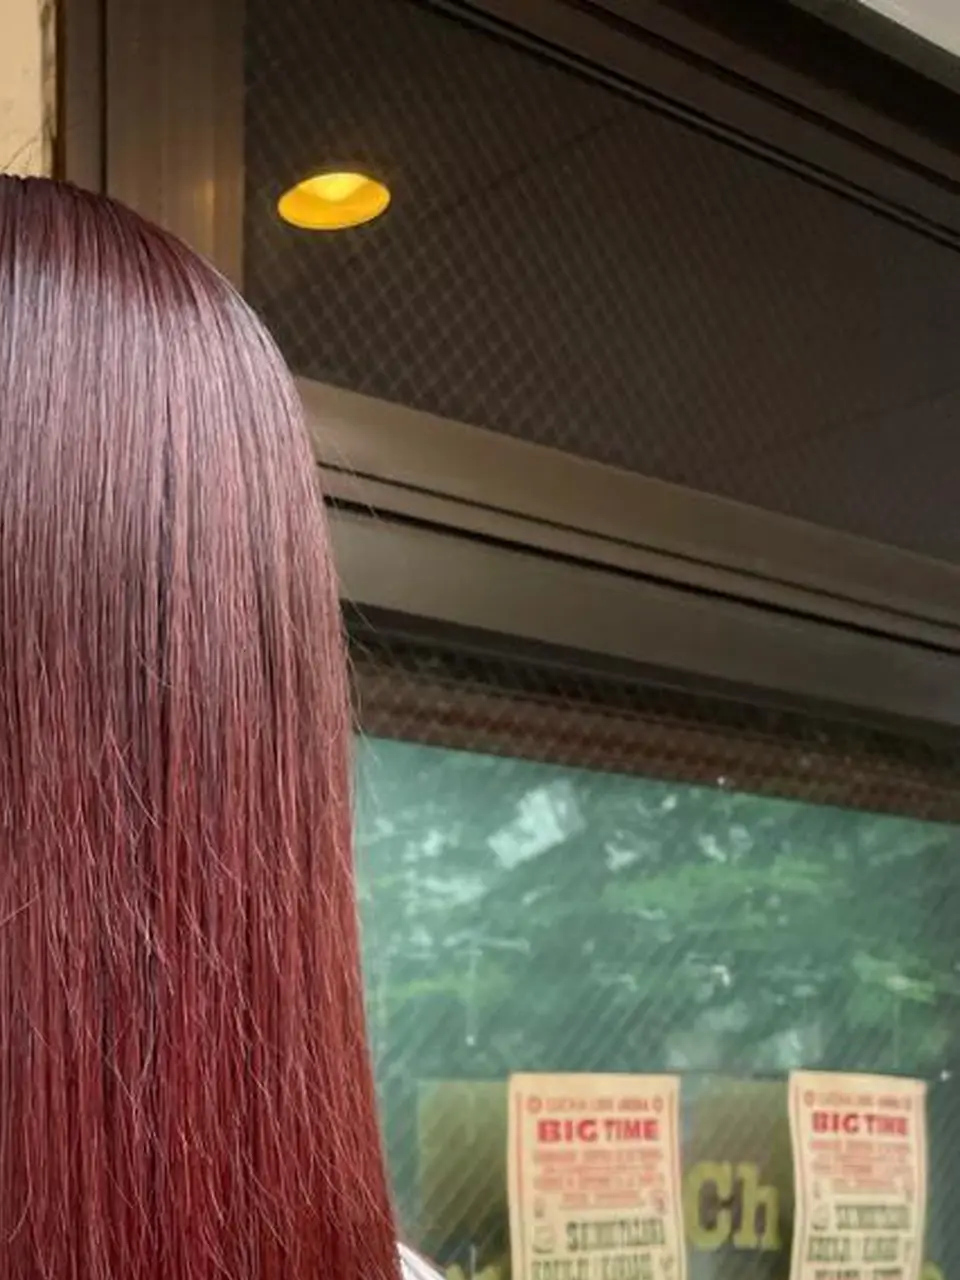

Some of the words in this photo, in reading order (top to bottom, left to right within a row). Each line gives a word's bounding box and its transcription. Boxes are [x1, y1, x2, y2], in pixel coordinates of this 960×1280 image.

[537, 1118, 599, 1143] BIG
[604, 1118, 660, 1142] TIME
[812, 1111, 860, 1134] BIG
[864, 1113, 909, 1137] TIME
